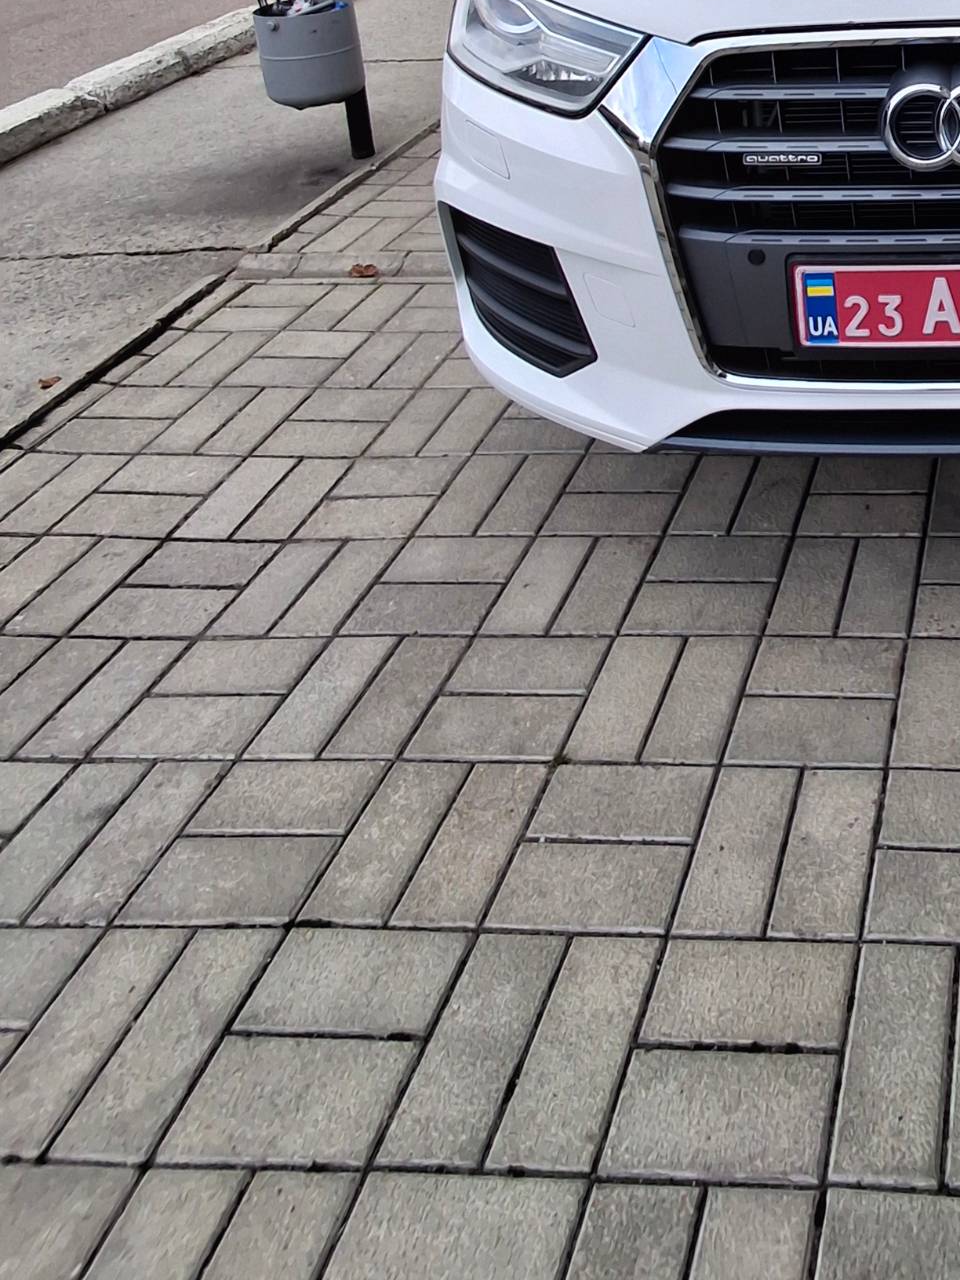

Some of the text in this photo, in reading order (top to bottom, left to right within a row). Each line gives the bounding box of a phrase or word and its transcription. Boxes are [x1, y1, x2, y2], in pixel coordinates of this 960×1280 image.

[745, 154, 818, 163] quattro
[808, 316, 838, 337] UA
[843, 295, 903, 337] 23
